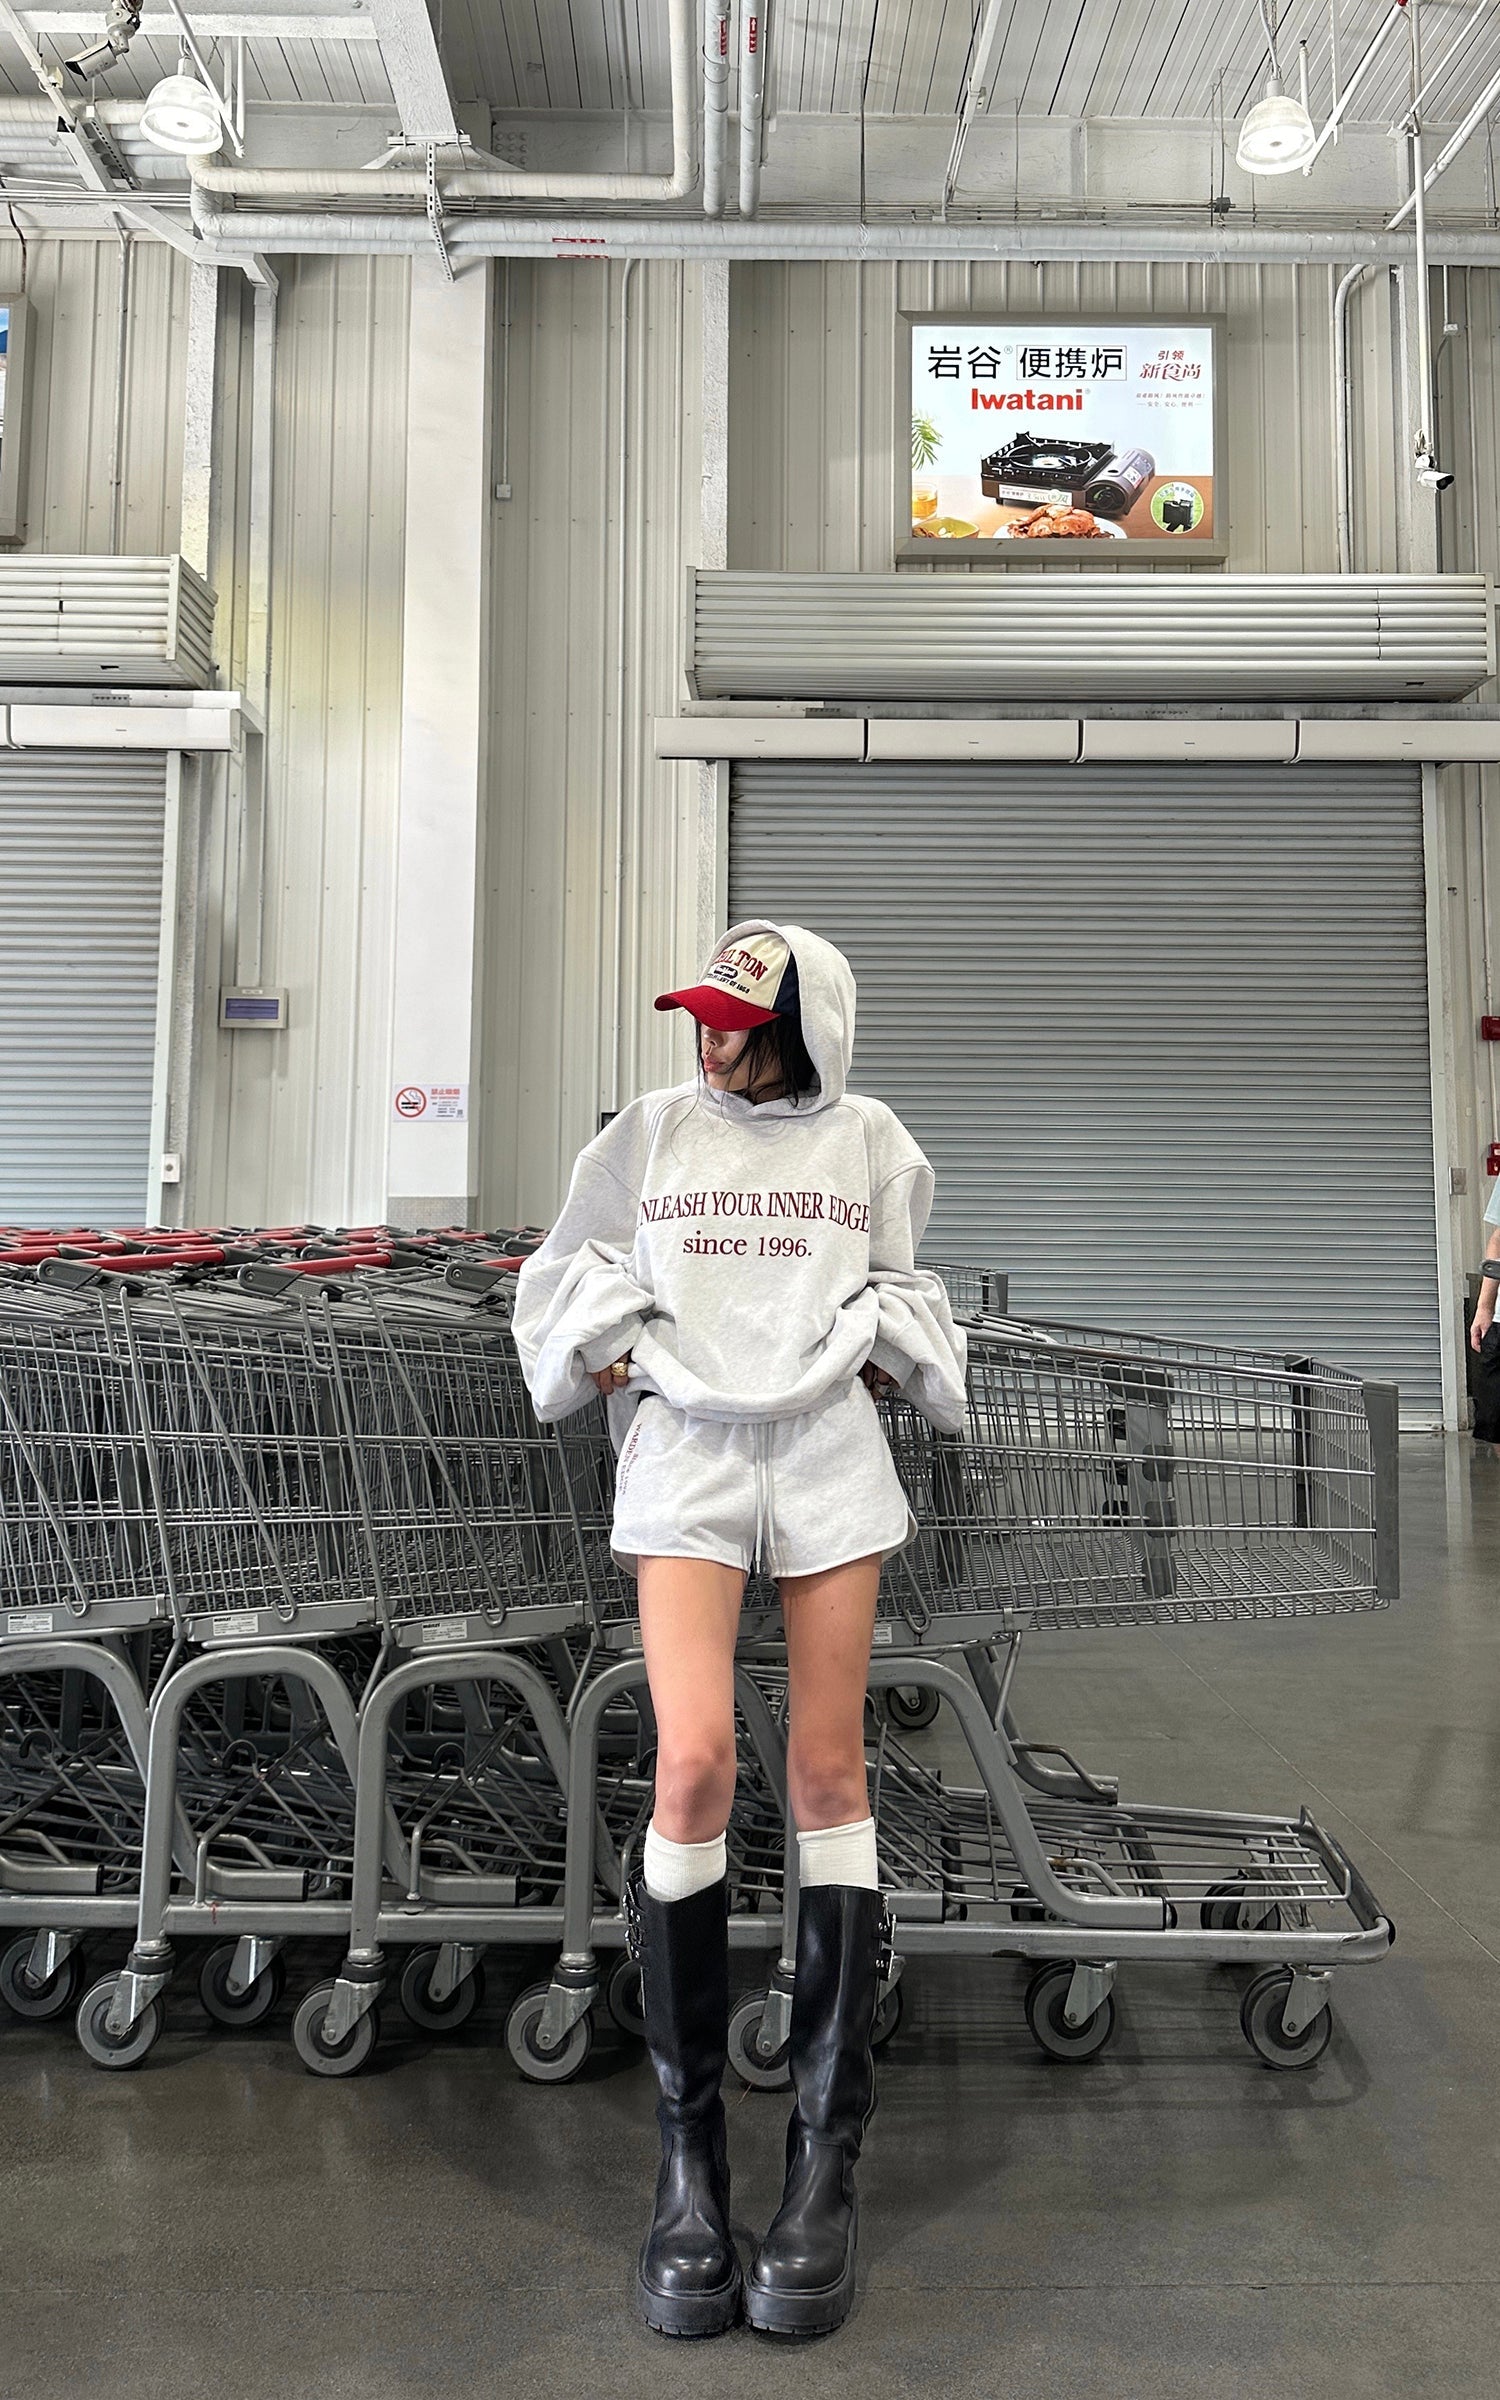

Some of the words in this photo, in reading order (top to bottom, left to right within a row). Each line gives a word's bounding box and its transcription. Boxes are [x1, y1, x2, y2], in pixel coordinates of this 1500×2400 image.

[928, 345, 1002, 379] 岩谷
[1019, 347, 1123, 379] 便携炉
[1157, 350, 1185, 361] 引领
[1139, 363, 1202, 382] 新食尚
[971, 388, 1083, 410] Iwatani
[638, 1192, 708, 1228] NLEASH
[712, 1191, 763, 1217] YOUR
[766, 1192, 825, 1219] INNER
[828, 1194, 870, 1234] EDGE
[683, 1230, 748, 1256] since
[758, 1236, 812, 1258] 1996.
